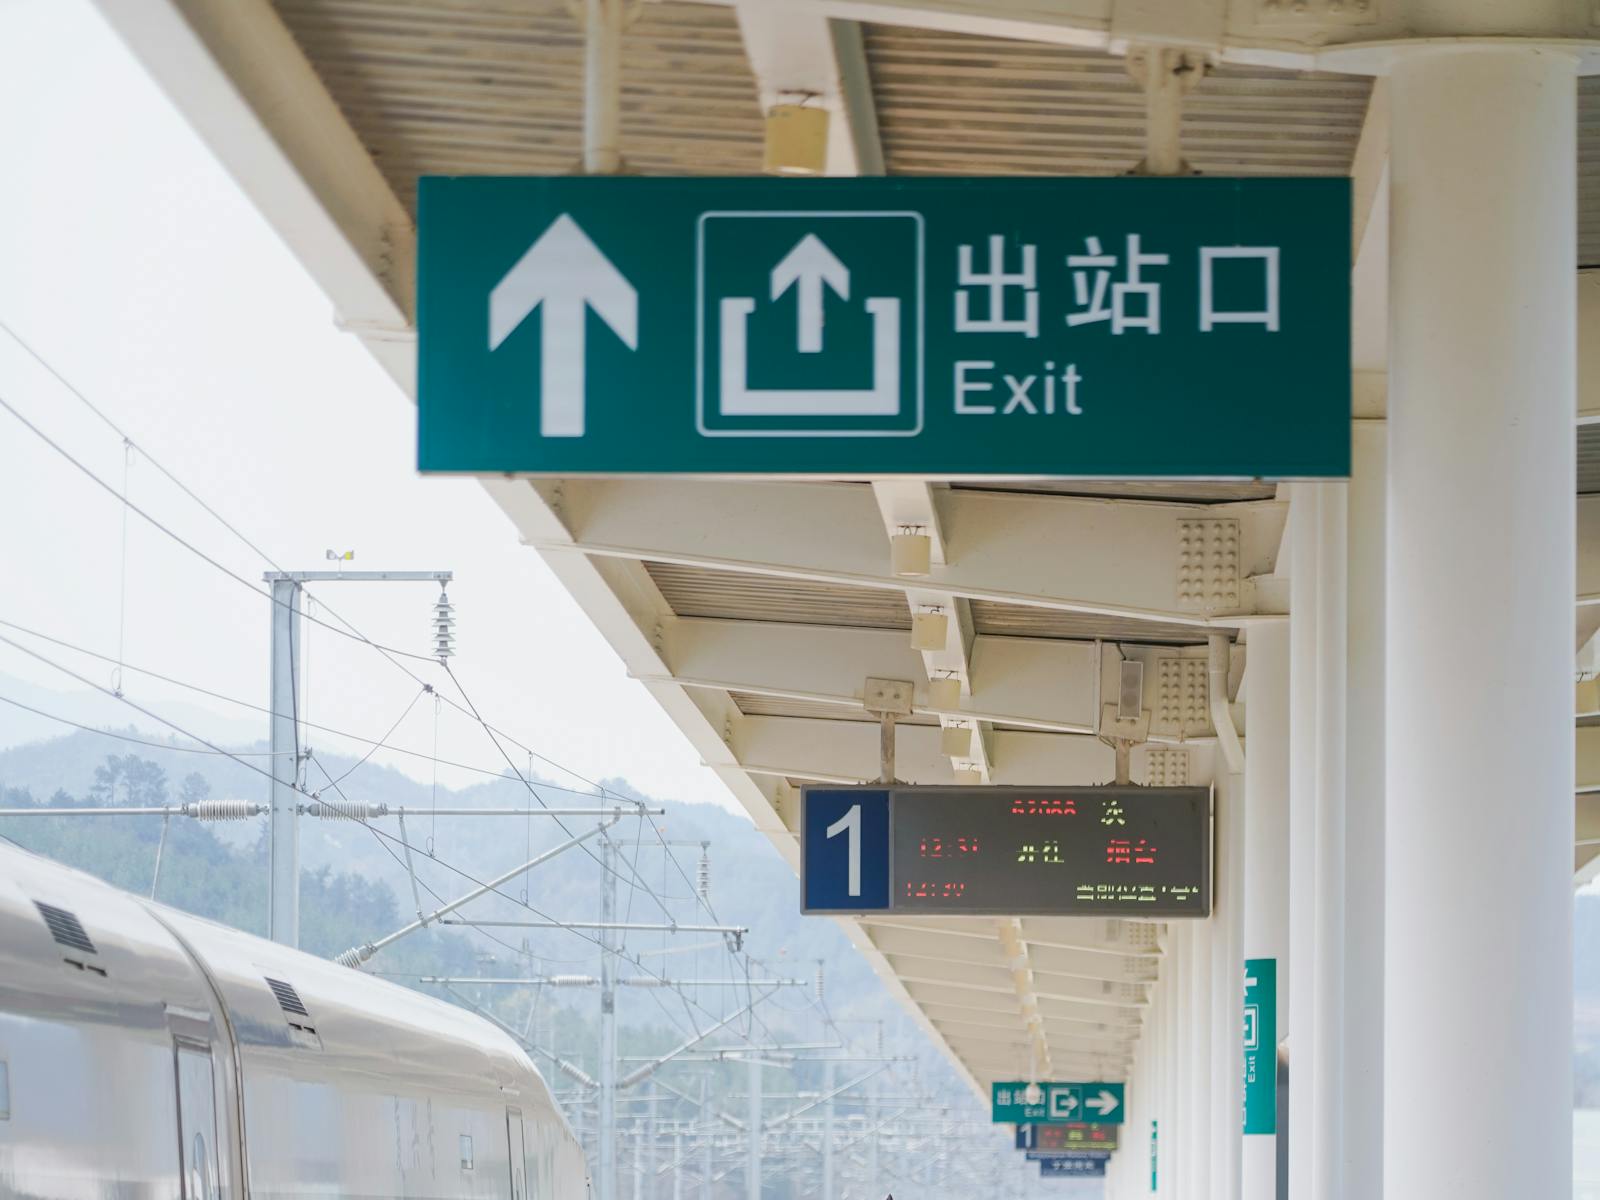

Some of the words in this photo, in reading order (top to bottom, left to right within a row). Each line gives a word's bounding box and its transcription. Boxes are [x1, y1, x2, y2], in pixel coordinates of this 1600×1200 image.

[953, 232, 1281, 338] 出站口
[953, 360, 1083, 415] Exit
[826, 804, 861, 897] 1
[1020, 1122, 1032, 1148] 1
